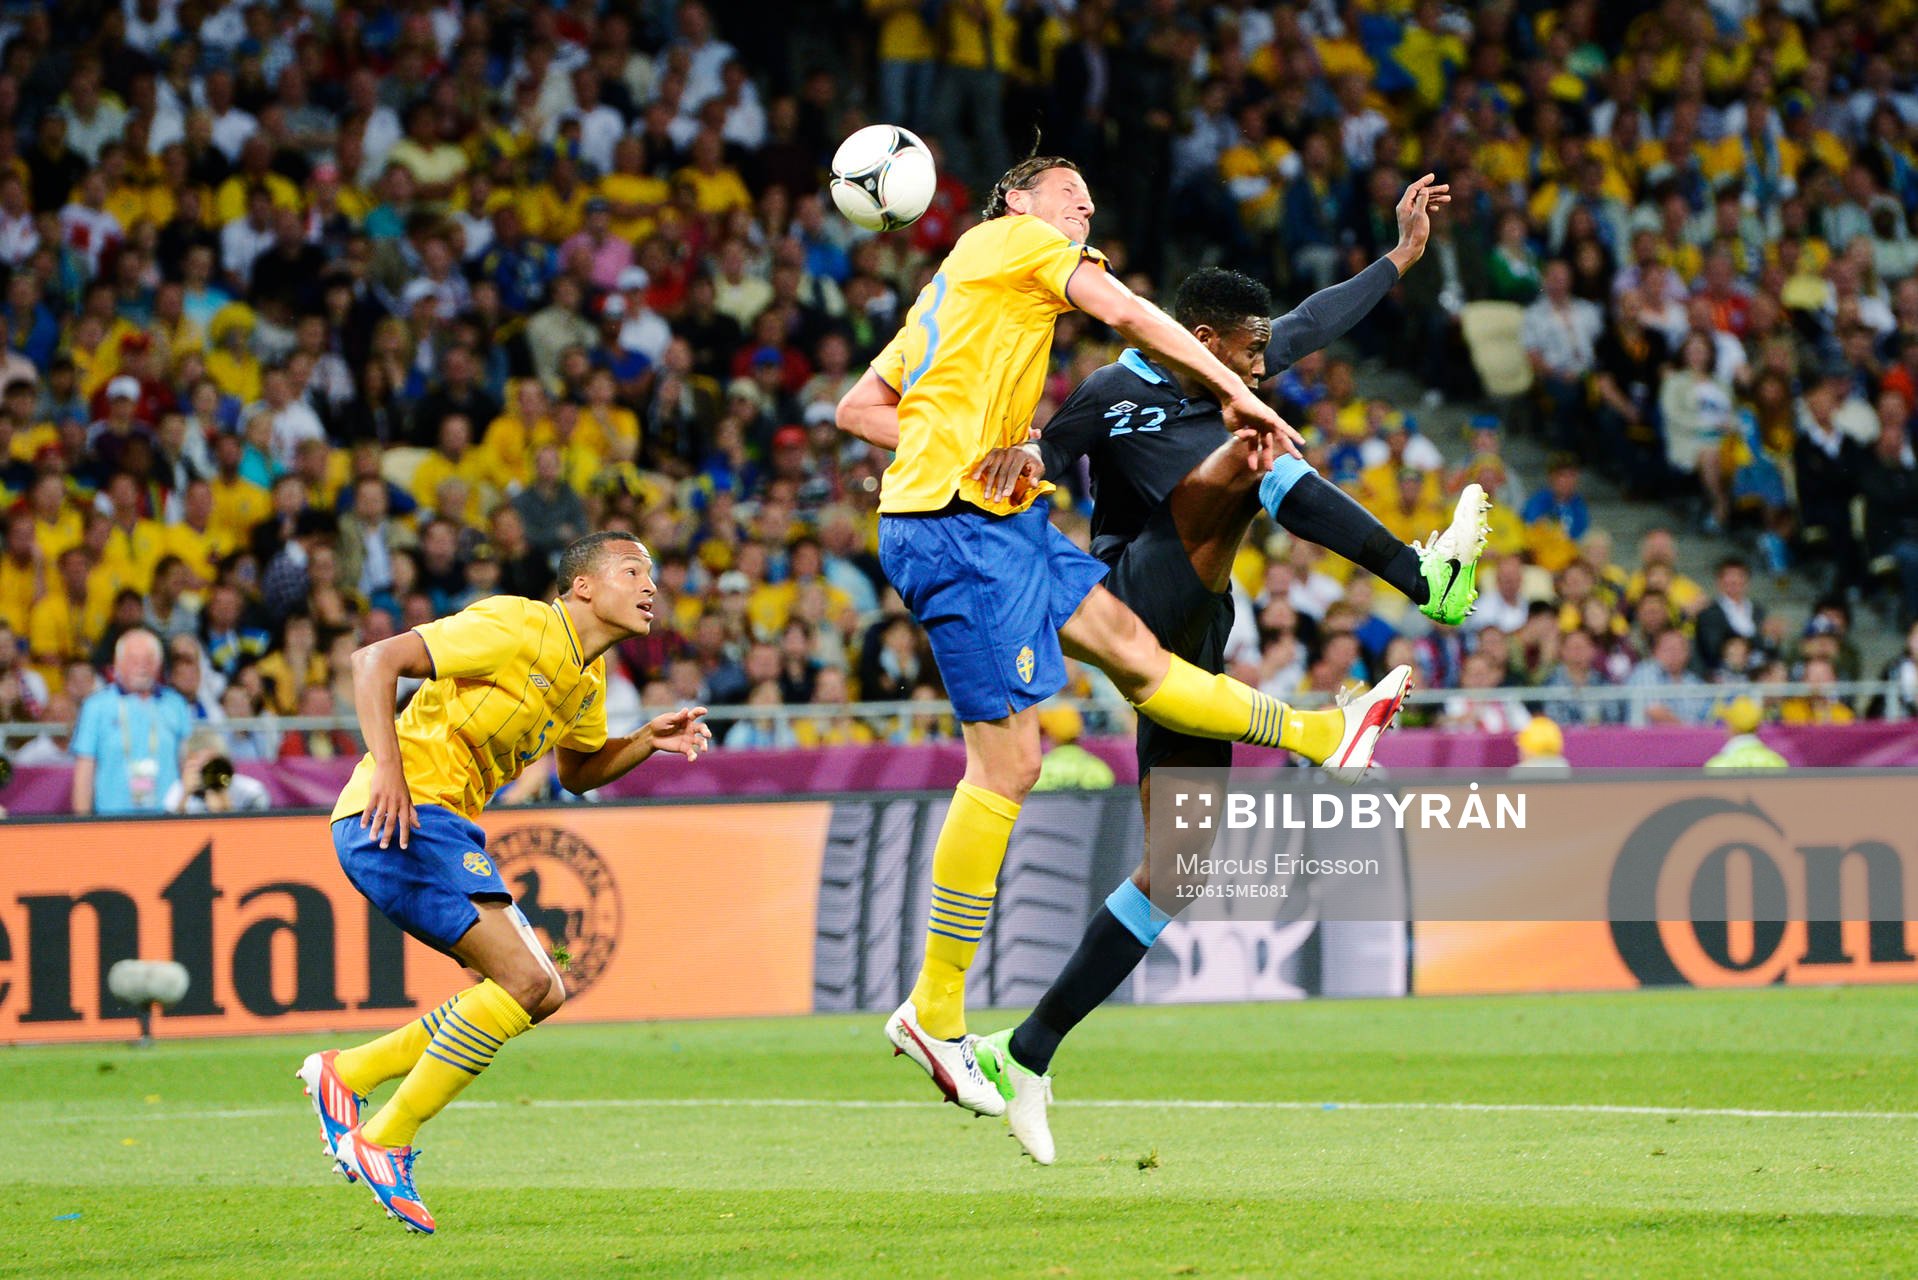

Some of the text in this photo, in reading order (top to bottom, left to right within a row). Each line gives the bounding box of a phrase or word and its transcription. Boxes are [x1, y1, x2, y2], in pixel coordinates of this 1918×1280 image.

[1103, 406, 1167, 438] 22
[519, 719, 554, 761] 5
[0, 835, 418, 1024] ntal
